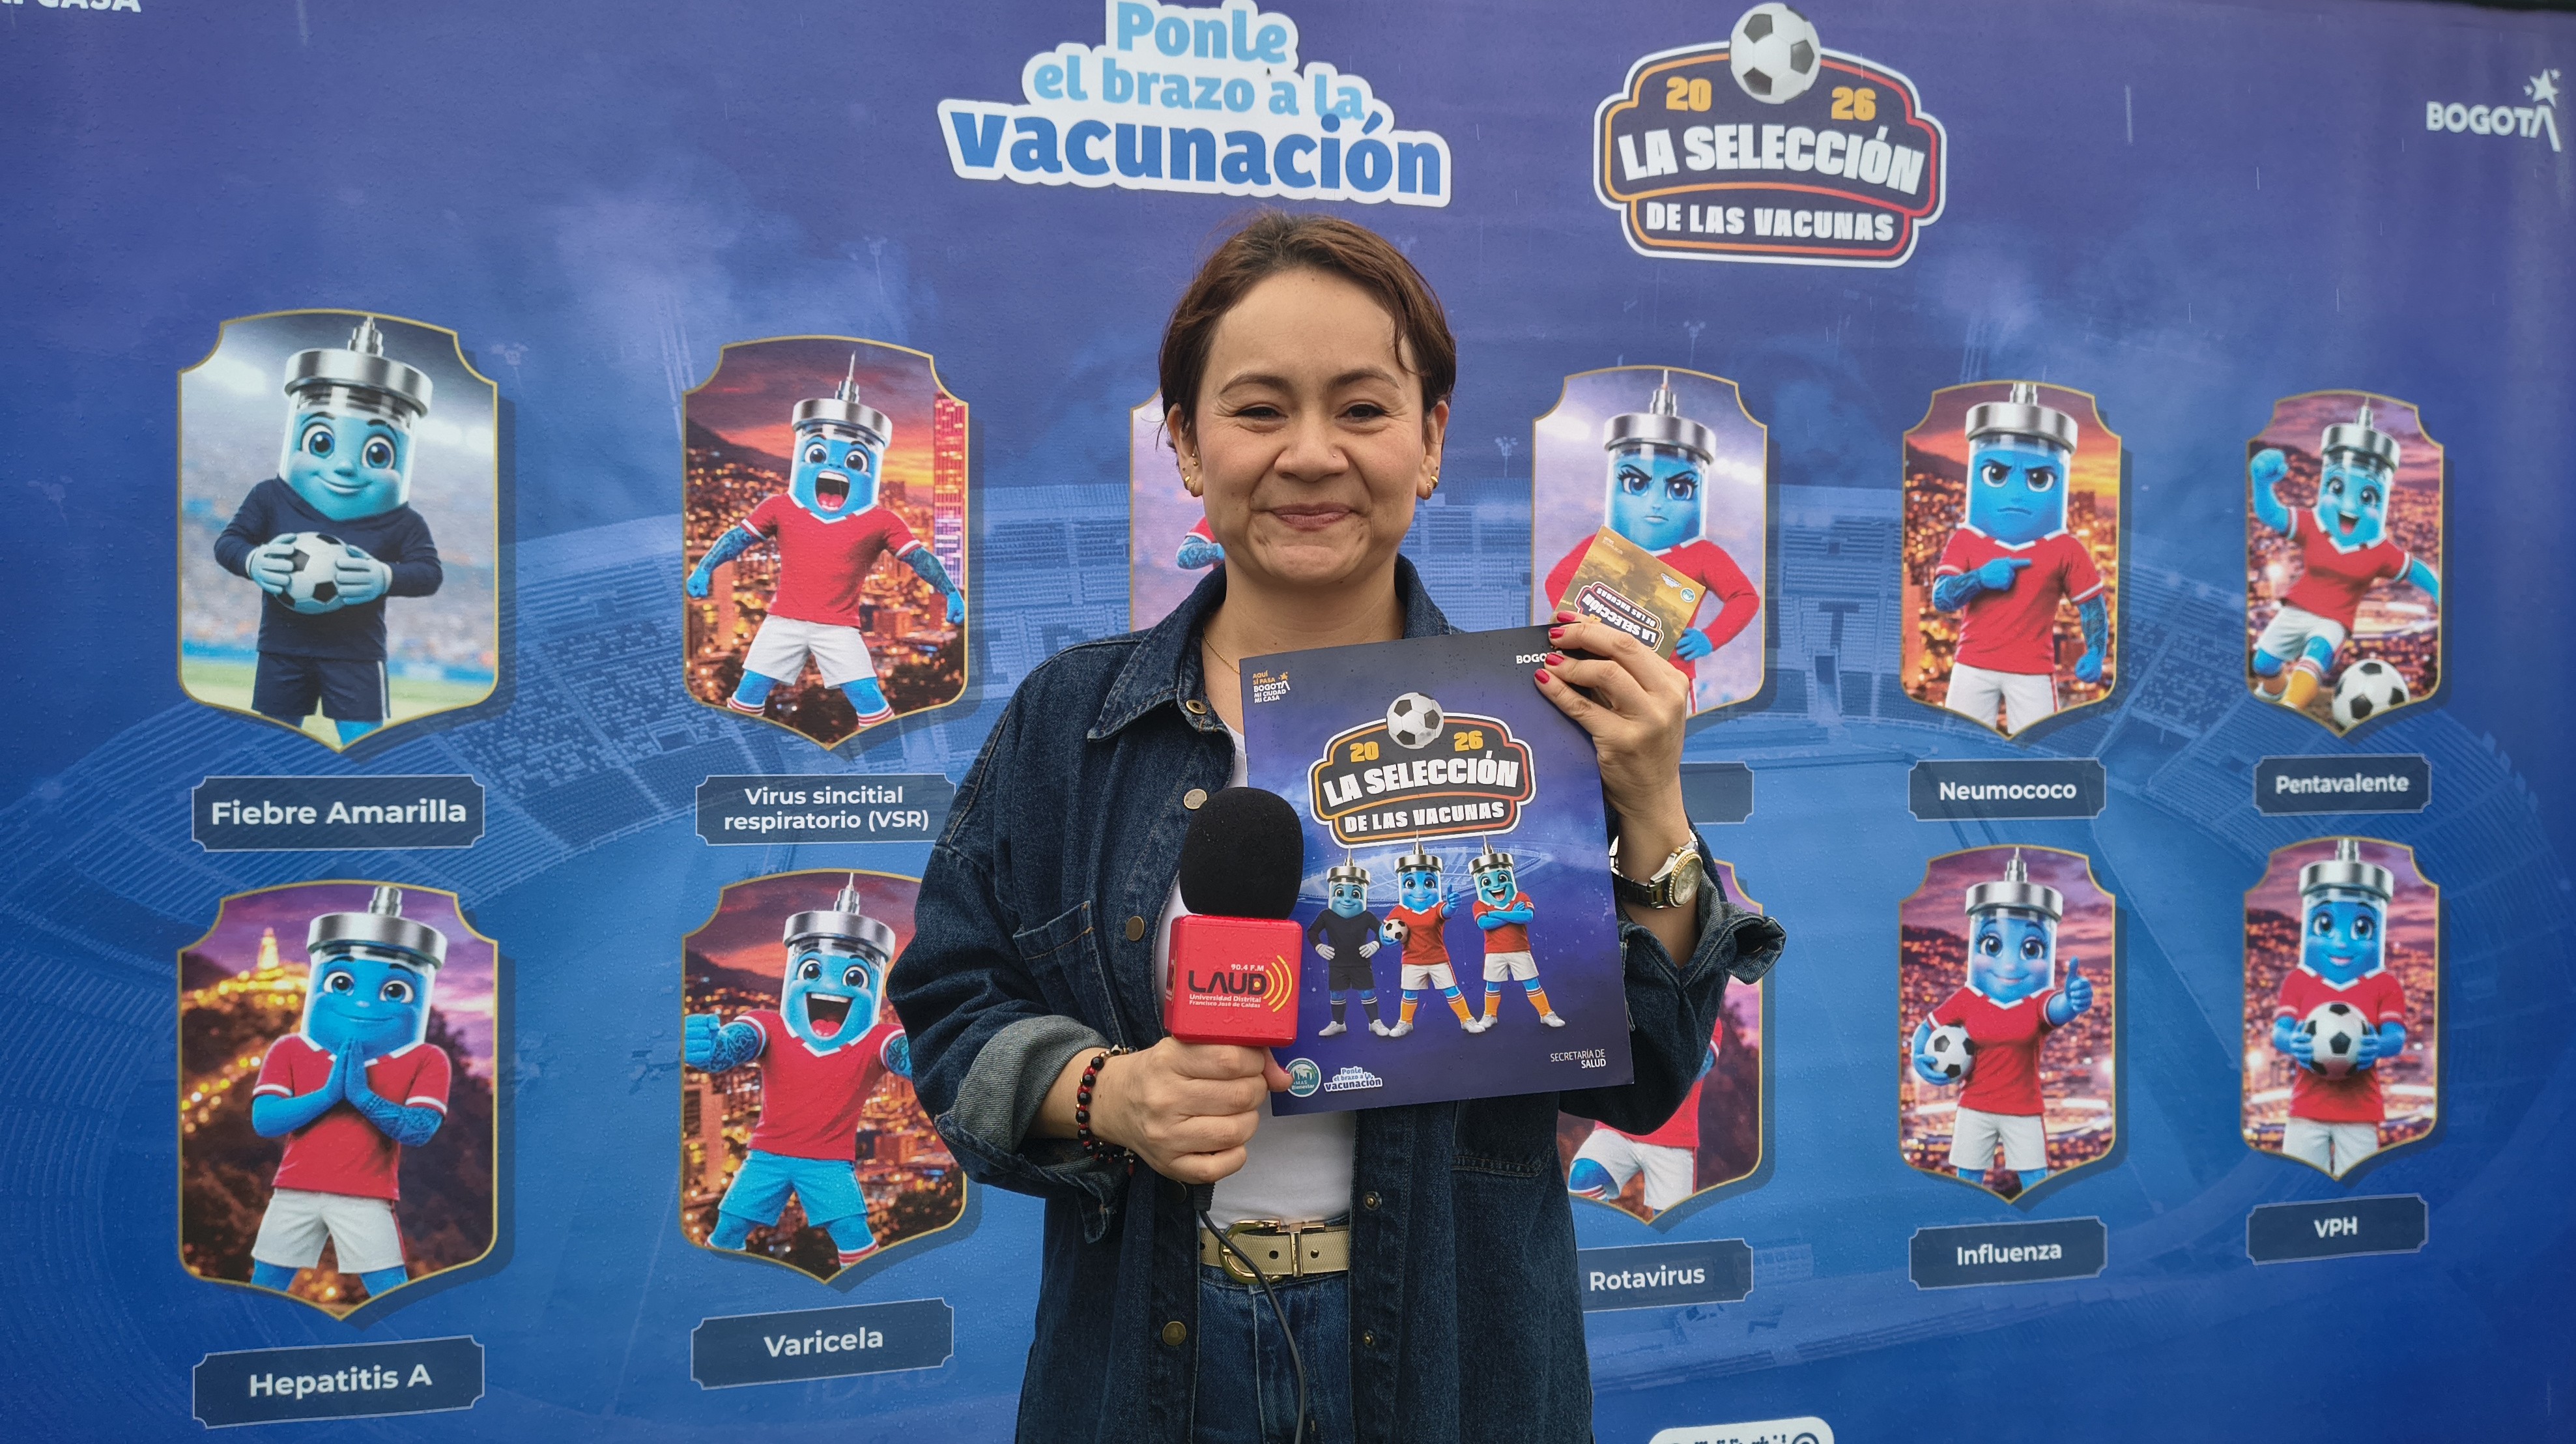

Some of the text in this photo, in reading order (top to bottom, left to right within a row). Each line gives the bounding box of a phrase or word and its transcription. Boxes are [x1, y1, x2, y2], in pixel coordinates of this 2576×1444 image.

[1117, 1, 1287, 64] Ponle
[1033, 55, 1366, 121] el brazo a la
[1666, 76, 1711, 112] 20
[1831, 86, 1876, 121] 26
[949, 109, 1442, 196] vacunación
[1618, 124, 1926, 195] LA SELECCIÓN
[1646, 202, 1895, 242] DE LAS VACUNAS
[1582, 593, 1656, 643] LA SELECCIÓN
[1516, 650, 1564, 664] BOGO
[1253, 670, 1268, 678] AQUÍ
[1349, 742, 1379, 762] 20
[1453, 730, 1483, 751] 26
[1323, 750, 1519, 807] LA SELECCIÓN
[1939, 782, 2077, 801] Neumococo
[2275, 772, 2410, 794] Pentavalente
[744, 785, 904, 805] Virus sincitial
[211, 798, 466, 825] Fiebre Amarilla
[724, 809, 930, 833] respiratorio (VSR)
[1345, 802, 1504, 833] DE LAS VACUNAS
[1188, 970, 1267, 995] LAUD
[1550, 1048, 1606, 1062] SECRETARÍA DE
[1581, 1059, 1607, 1069] SALUD
[1325, 1076, 1381, 1090] vacunación
[2314, 1217, 2358, 1239] VPH
[1956, 1241, 2063, 1266] Influenza
[1590, 1265, 1706, 1292] Rotavirus
[763, 1327, 883, 1357] Varicela
[250, 1363, 433, 1400] Hepatitis A
